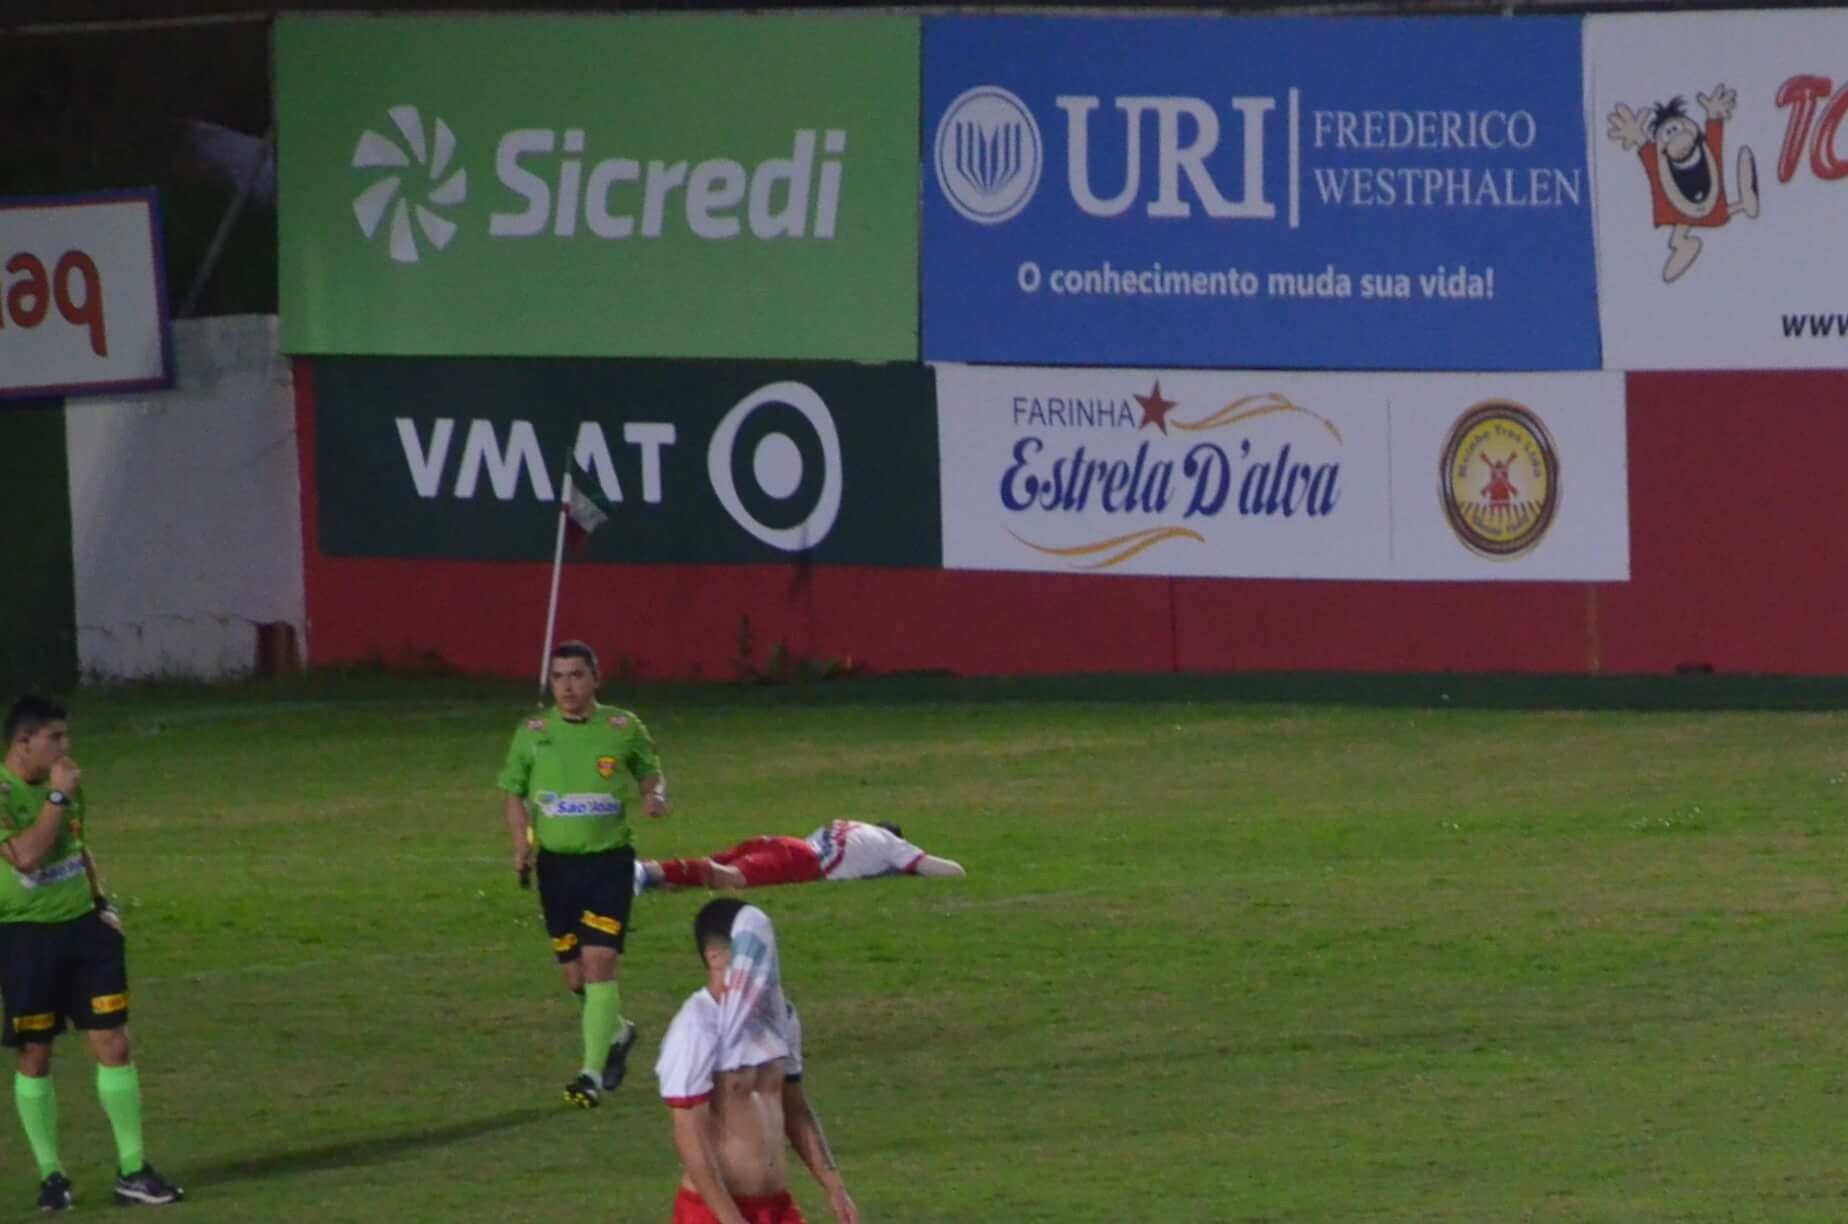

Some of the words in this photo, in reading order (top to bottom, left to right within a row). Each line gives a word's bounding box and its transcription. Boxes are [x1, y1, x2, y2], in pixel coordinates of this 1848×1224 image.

[1313, 110, 1537, 150] FREDERICO
[1056, 96, 1276, 219] URI
[489, 129, 846, 241] Sicredi
[1313, 167, 1580, 207] WESTPHALEN
[1018, 261, 1041, 294] O
[1050, 261, 1259, 297] conhecimento
[1268, 264, 1352, 298] muda
[1360, 273, 1411, 299] sua
[1420, 265, 1494, 299] vida!
[1012, 395, 1137, 428] FARINHA
[1000, 436, 1174, 514] Estrela
[1183, 438, 1341, 519] D'alva
